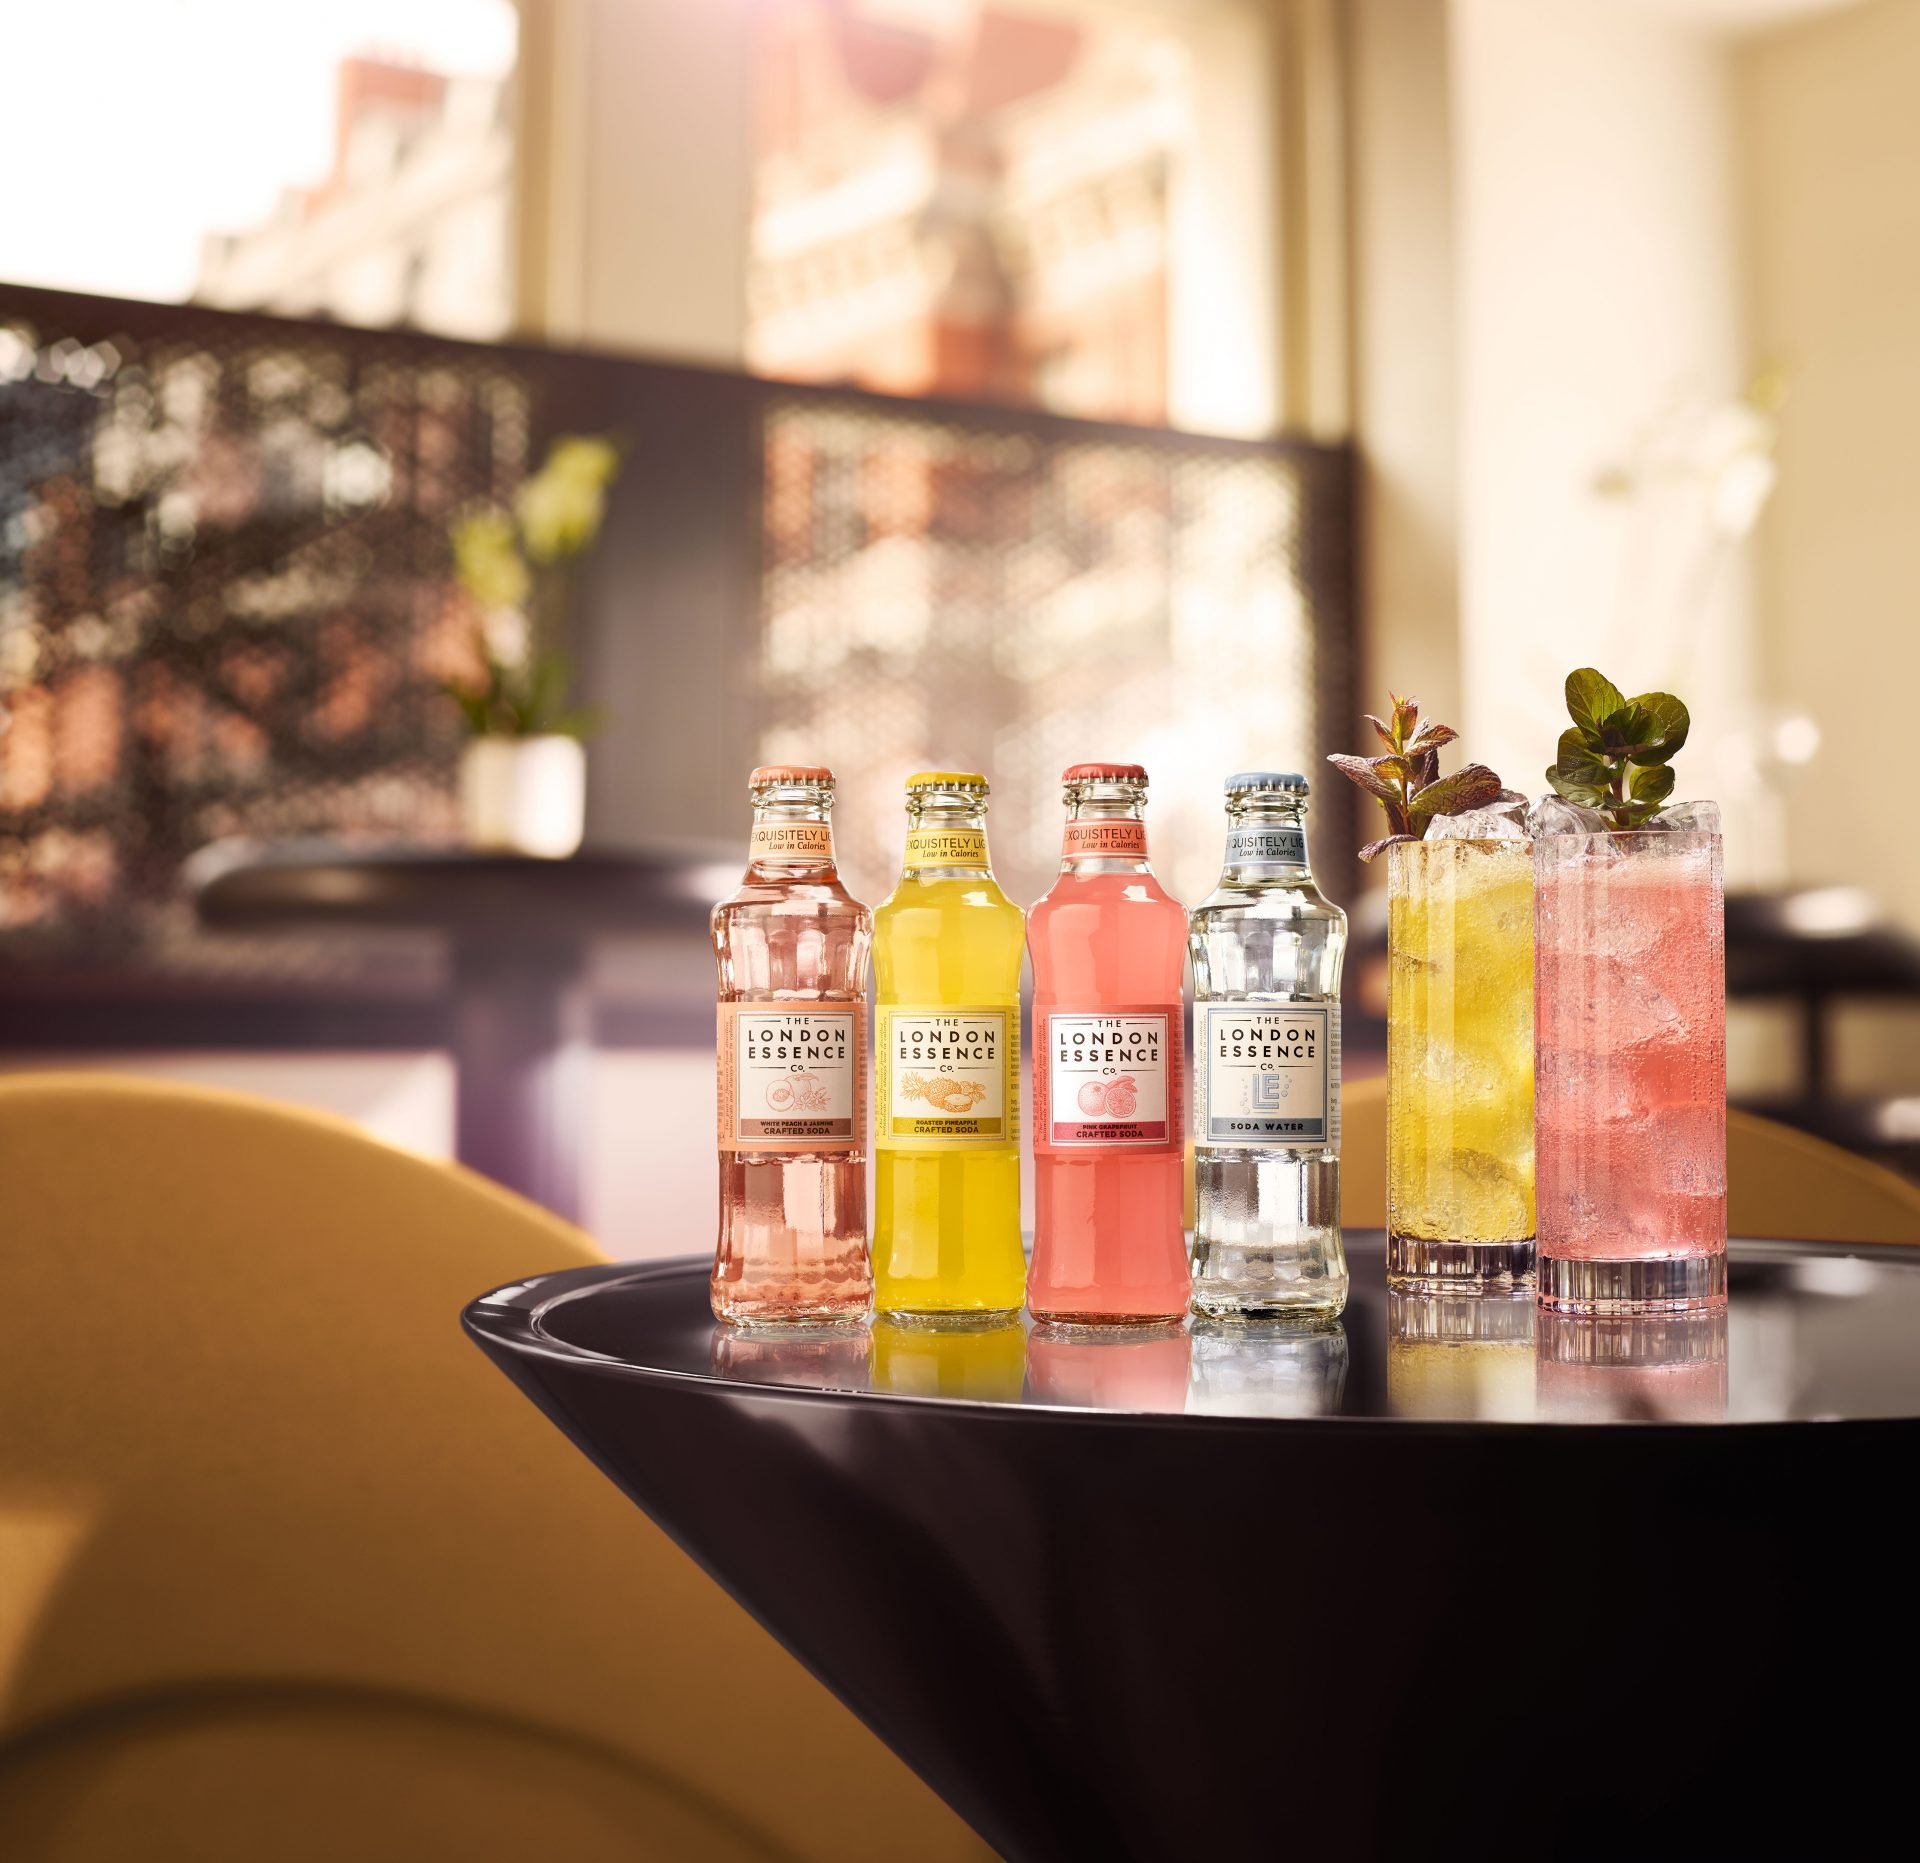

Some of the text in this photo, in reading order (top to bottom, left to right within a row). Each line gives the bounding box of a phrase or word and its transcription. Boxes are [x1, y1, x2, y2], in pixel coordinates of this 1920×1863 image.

[769, 842, 784, 850] Low
[797, 842, 826, 850] Calories
[1082, 841, 1098, 849] Low
[1111, 840, 1139, 848] Calories
[1228, 837, 1287, 848] QUISITELY
[923, 850, 937, 858] Low
[950, 849, 979, 857] Calories
[1240, 848, 1296, 856] Low in Calories
[748, 1029, 845, 1042] LONDON
[900, 1031, 995, 1043] LONDON
[1061, 1032, 1158, 1045] LONDON
[1220, 1029, 1315, 1041] LONDON
[748, 1046, 845, 1060] ESSENCE
[900, 1047, 995, 1060] ESSENCE
[1061, 1049, 1158, 1062] ESSENCE
[1220, 1046, 1315, 1058] ESSENCE
